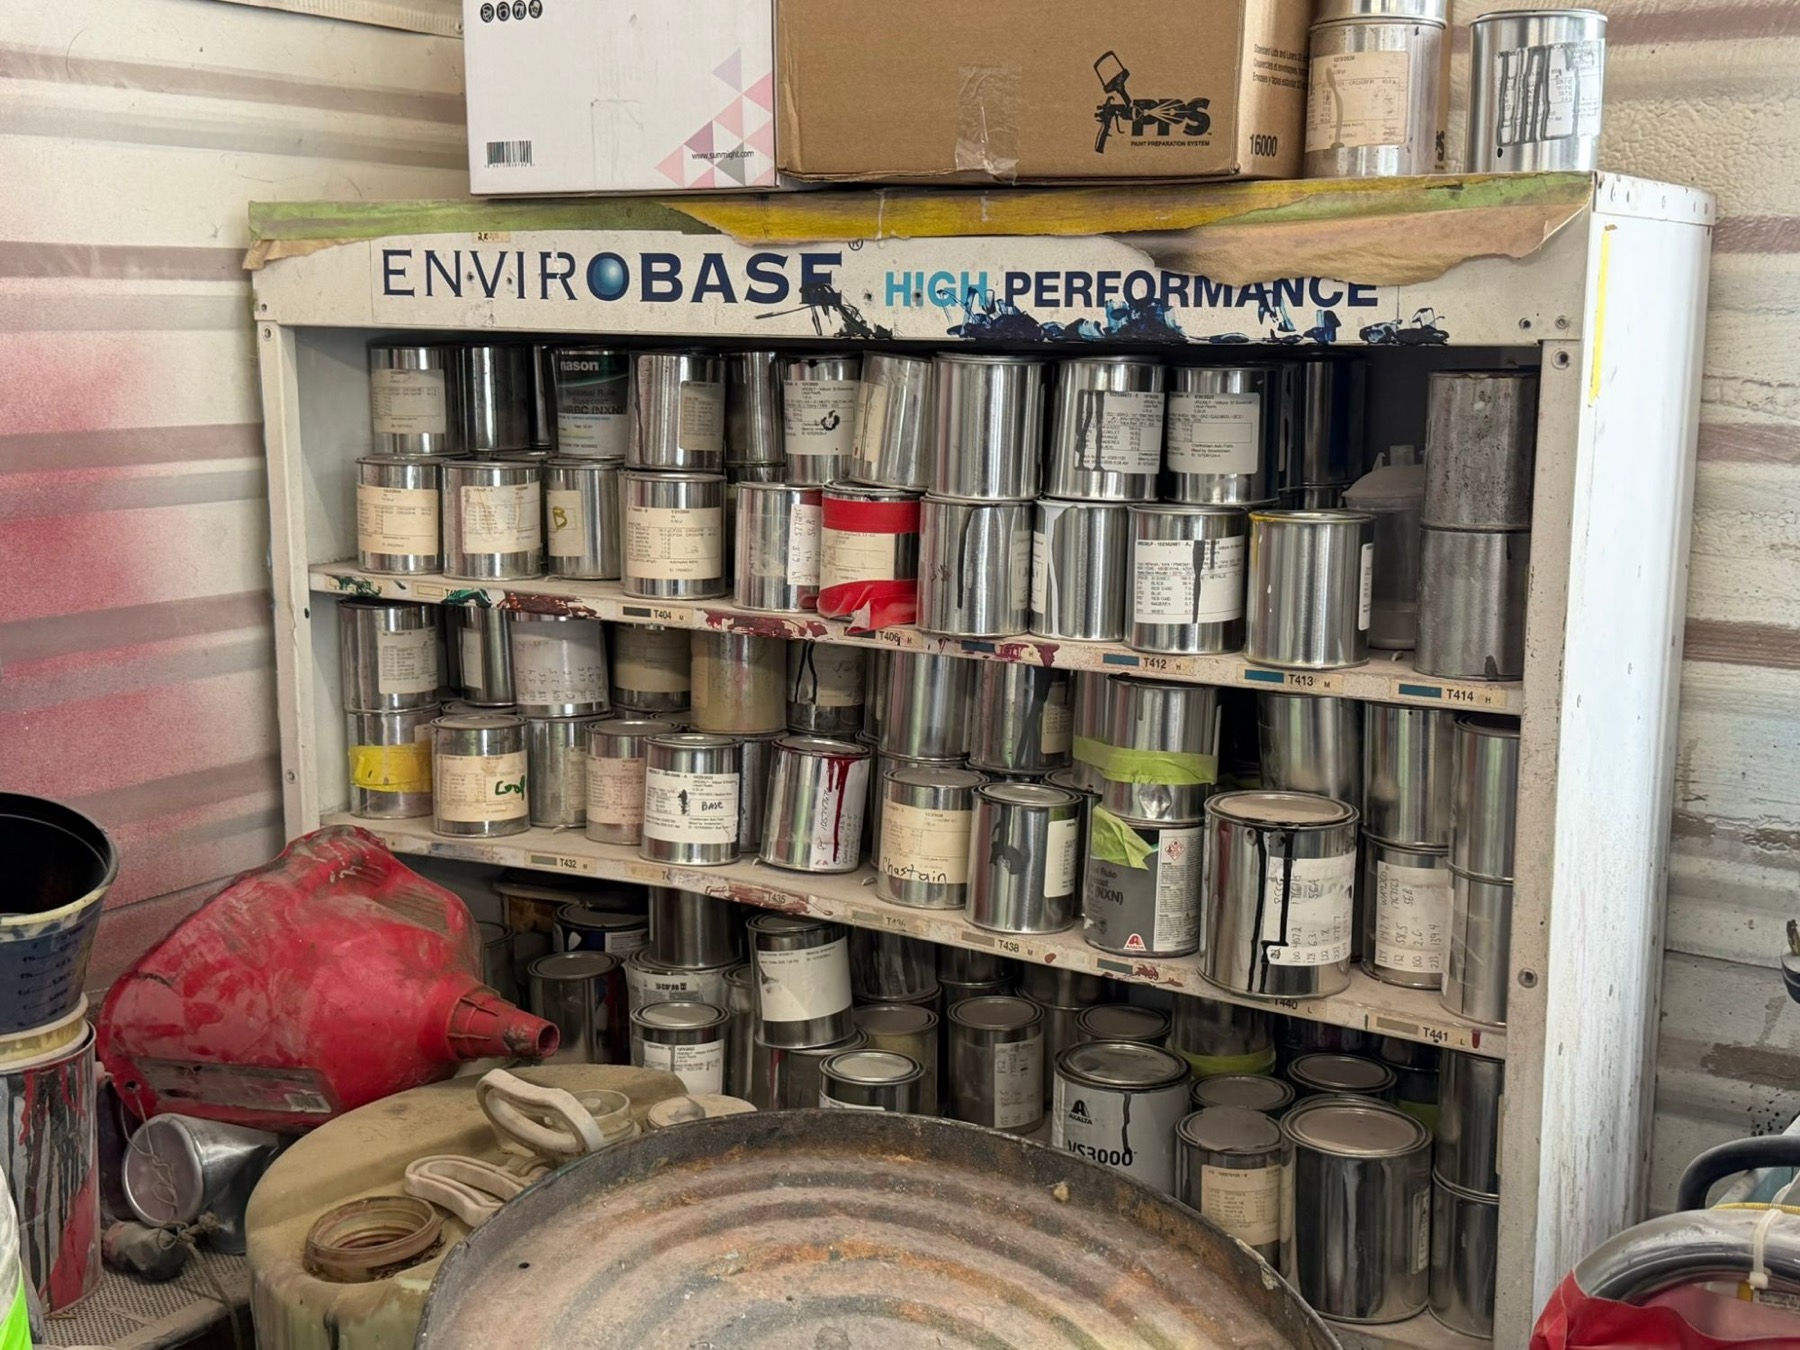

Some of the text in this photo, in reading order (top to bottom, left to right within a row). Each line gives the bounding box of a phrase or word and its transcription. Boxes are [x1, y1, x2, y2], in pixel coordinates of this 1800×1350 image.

[1131, 97, 1211, 137] PPS
[1147, 140, 1186, 148] PREPARATION
[1250, 133, 1278, 158] 16000
[691, 150, 754, 161] www.sunmight.com
[382, 247, 843, 305] ENVIROBASE
[885, 270, 1379, 309] HIGH PERFORMANCE
[653, 609, 672, 620] T404
[879, 630, 899, 643] T406
[1144, 657, 1167, 670] T412
[1288, 674, 1331, 689] T413 M
[1446, 688, 1491, 704] T414 H
[559, 858, 577, 870] T432
[882, 856, 947, 884] Chastain
[998, 939, 1020, 953] T438
[1274, 998, 1312, 1014] T440 L
[1423, 1027, 1448, 1042] T441
[1068, 1113, 1093, 1126] AXALTA
[1067, 1139, 1133, 1167] VS3000
